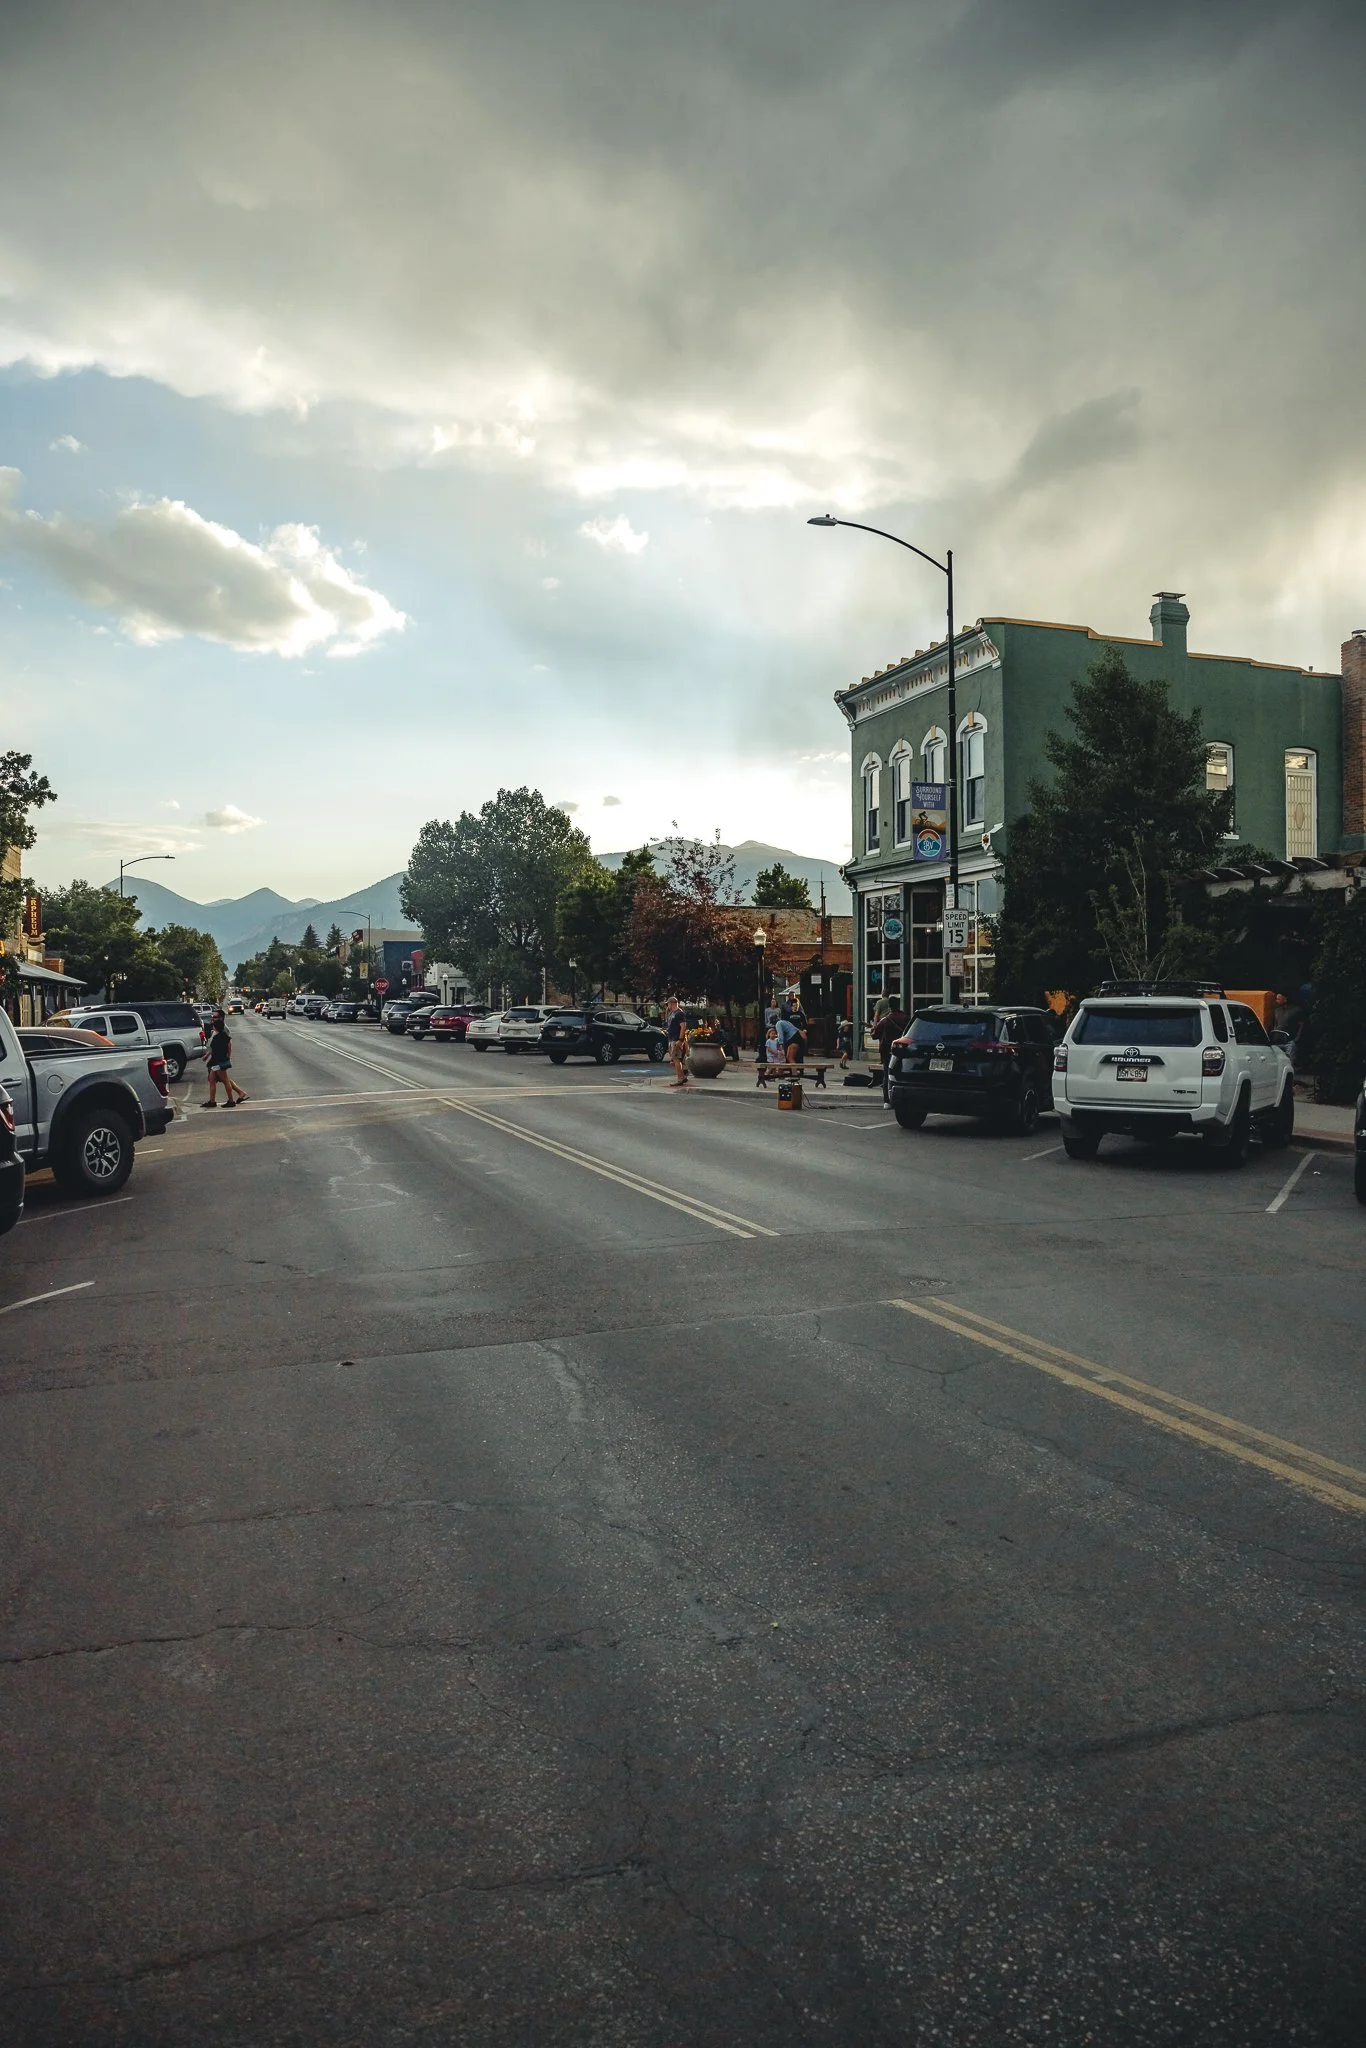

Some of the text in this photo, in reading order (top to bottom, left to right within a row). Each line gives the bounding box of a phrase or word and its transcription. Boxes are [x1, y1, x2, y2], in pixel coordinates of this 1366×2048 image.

[916, 786, 942, 794] SURROUND
[916, 793, 941, 801] YOURSELF
[945, 913, 967, 921] SPEED
[948, 930, 964, 944] 15
